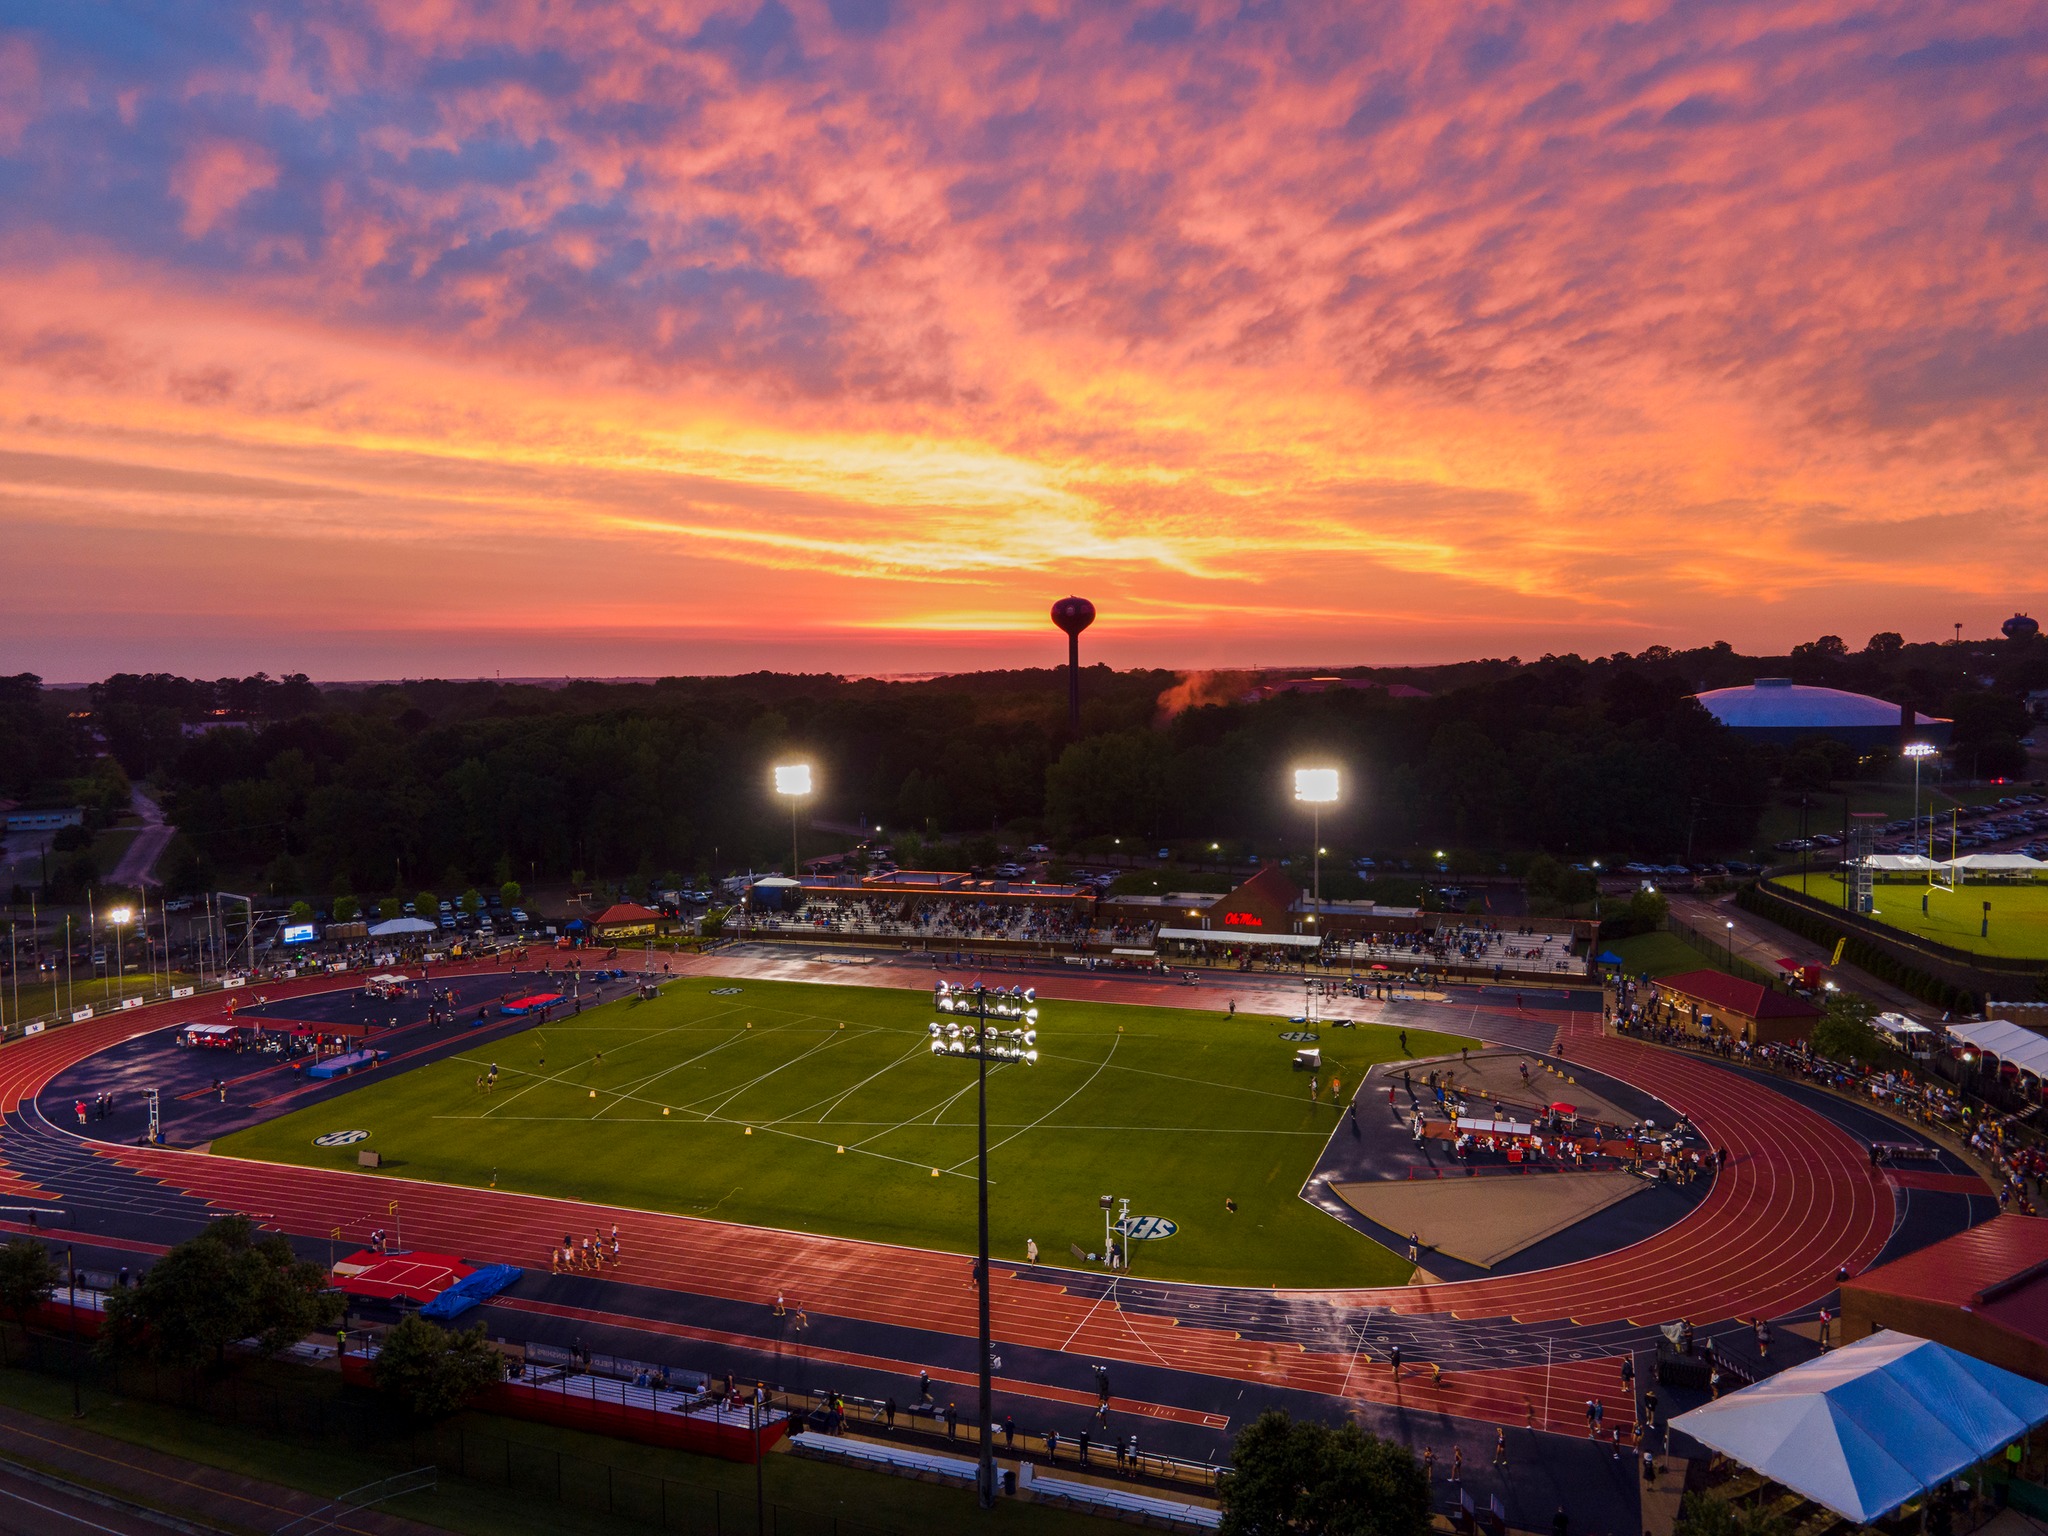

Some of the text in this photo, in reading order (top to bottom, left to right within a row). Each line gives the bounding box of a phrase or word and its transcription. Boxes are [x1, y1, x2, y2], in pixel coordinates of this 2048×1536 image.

[1225, 912, 1262, 926] Ole Miss
[1280, 1032, 1318, 1042] SEC
[1118, 1216, 1174, 1239] SEC
